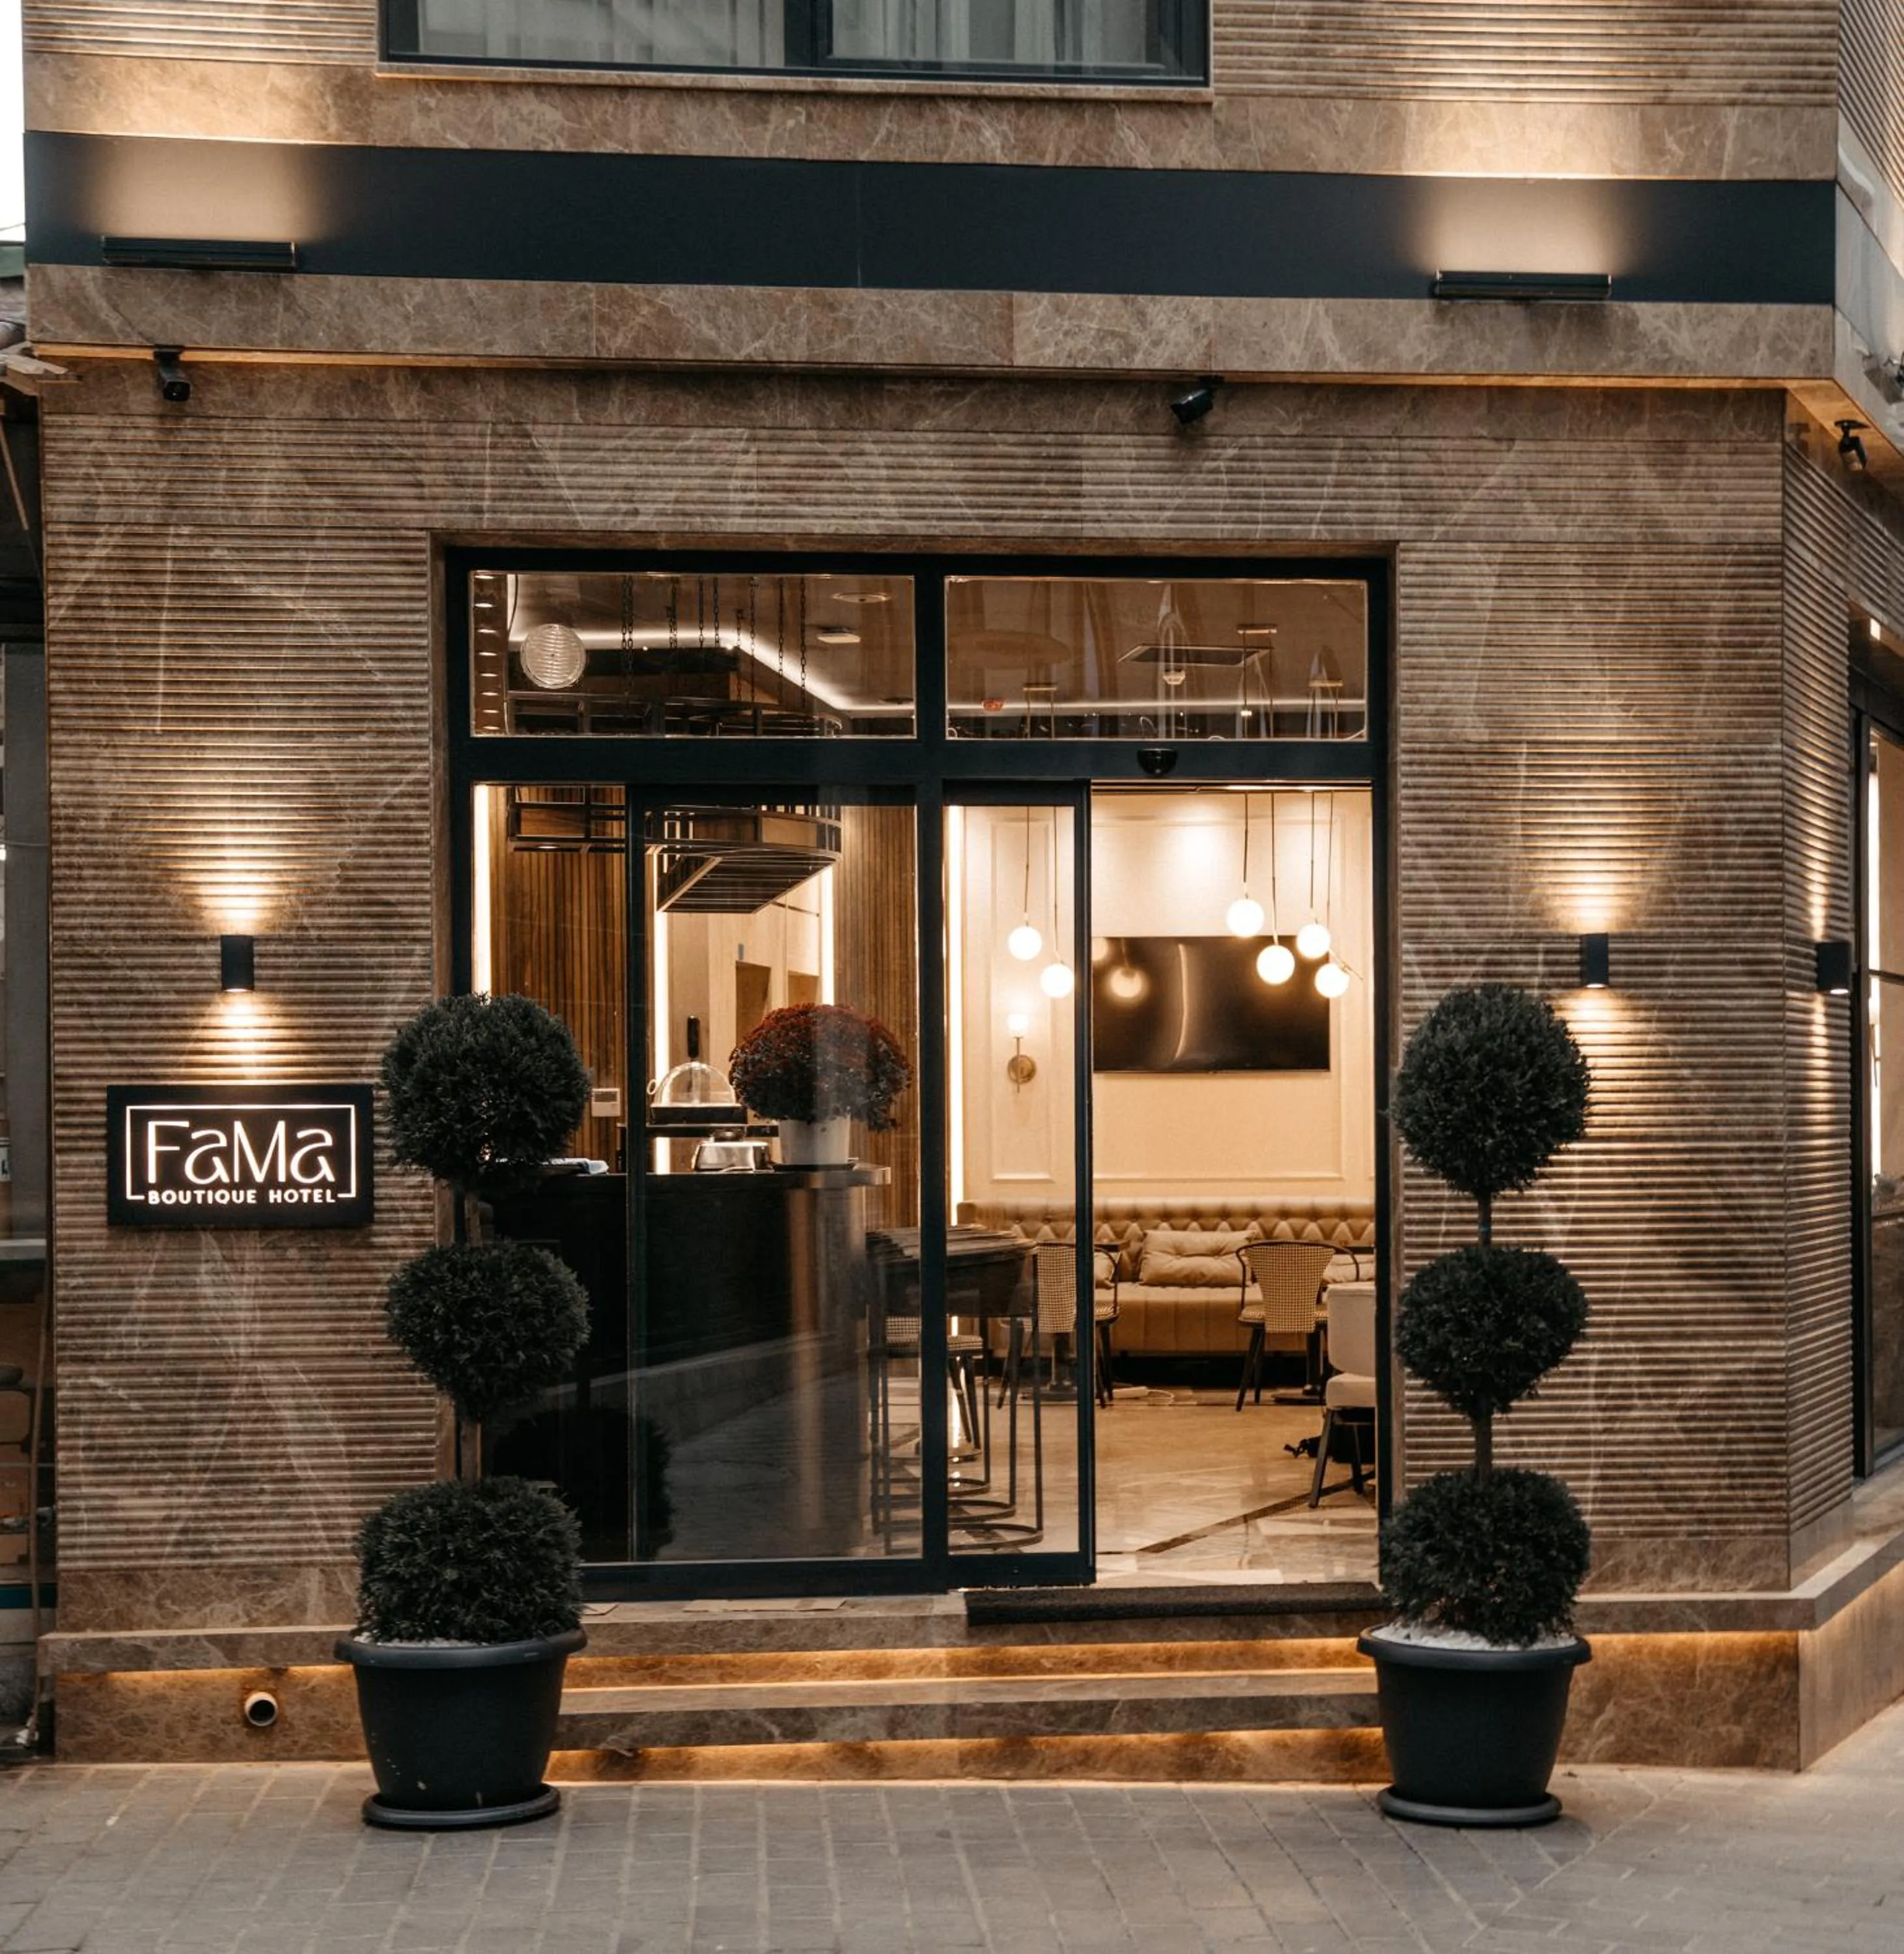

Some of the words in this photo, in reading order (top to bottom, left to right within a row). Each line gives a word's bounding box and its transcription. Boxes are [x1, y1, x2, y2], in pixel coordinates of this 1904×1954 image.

[147, 1120, 335, 1185] FaMa
[148, 1189, 257, 1205] BOUTIQUE
[269, 1189, 336, 1204] HOTEL
